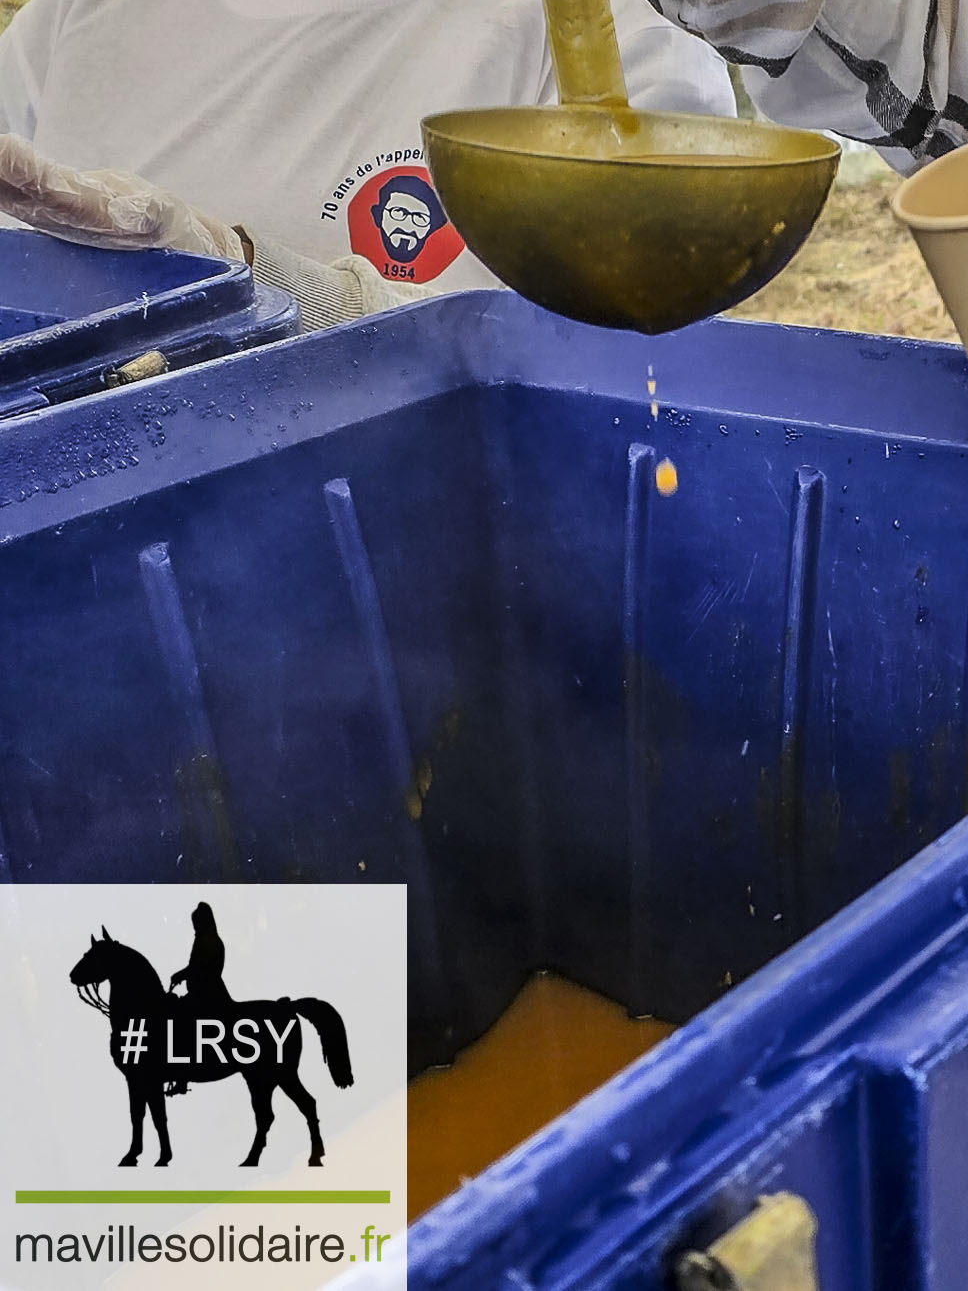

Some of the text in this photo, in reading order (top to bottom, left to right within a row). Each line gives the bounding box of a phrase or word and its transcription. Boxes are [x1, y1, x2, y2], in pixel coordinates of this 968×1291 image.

[321, 202, 338, 221] 70
[333, 177, 355, 200] ans
[356, 163, 373, 178] de
[383, 263, 415, 279] 1954
